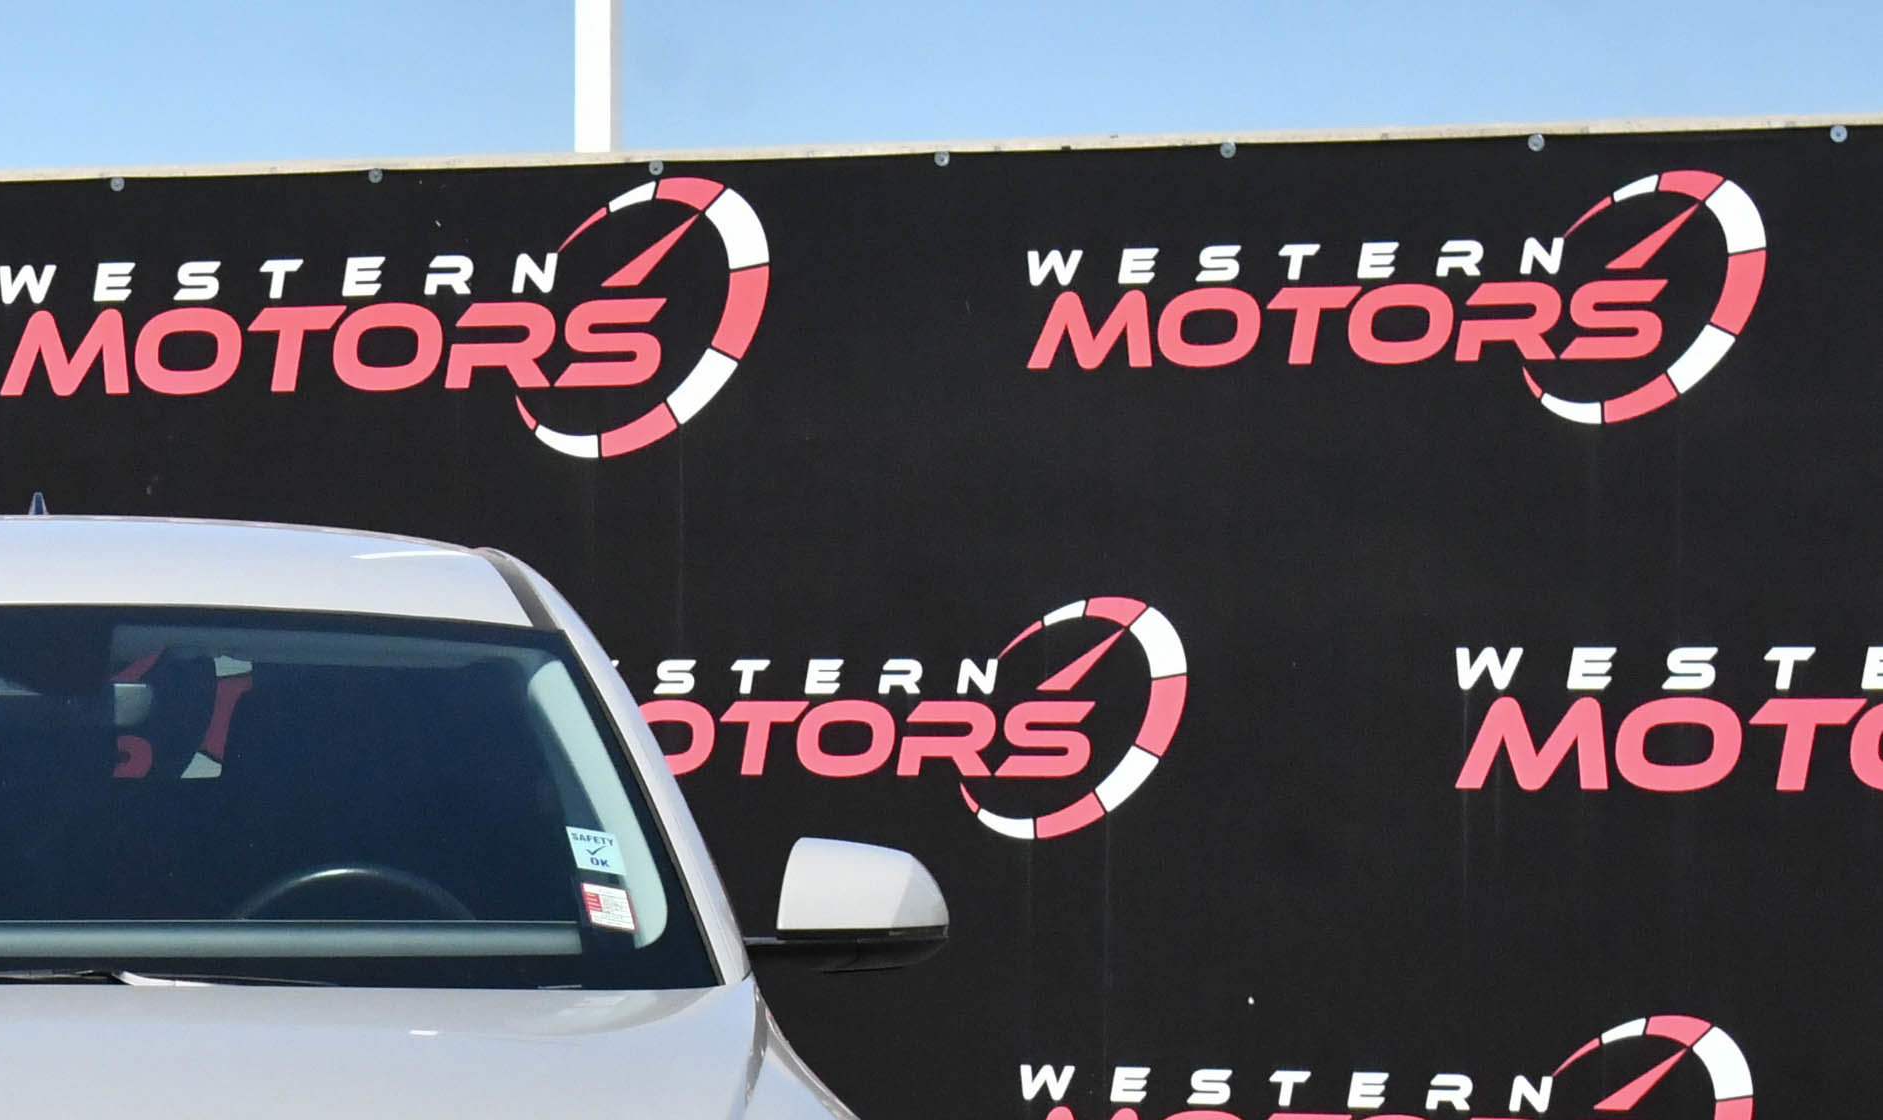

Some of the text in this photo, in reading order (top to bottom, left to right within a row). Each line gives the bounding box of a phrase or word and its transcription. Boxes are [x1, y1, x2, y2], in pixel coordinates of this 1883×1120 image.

[0, 253, 558, 304] WESTERN
[1028, 237, 1564, 286] WESTERN
[0, 297, 667, 397] MOTORS
[1028, 279, 1668, 370] MOTORS
[611, 659, 998, 694] STERN
[1455, 696, 1883, 793] MOT
[571, 832, 613, 846] SAFETY
[590, 857, 611, 868] OK
[1020, 1065, 1553, 1114] WESTERN
